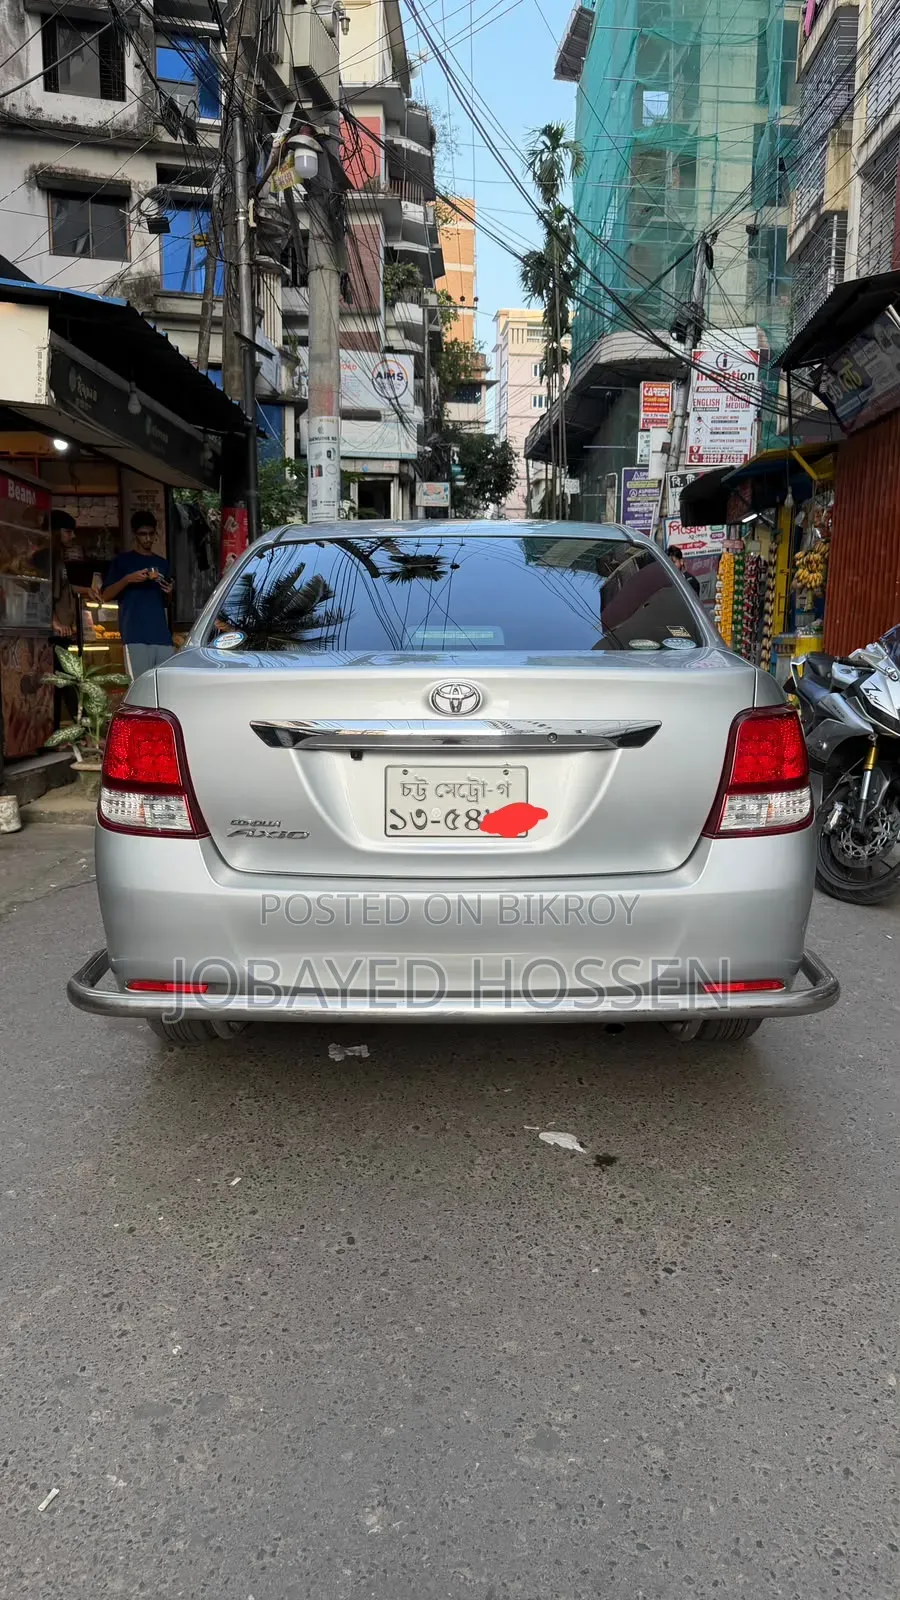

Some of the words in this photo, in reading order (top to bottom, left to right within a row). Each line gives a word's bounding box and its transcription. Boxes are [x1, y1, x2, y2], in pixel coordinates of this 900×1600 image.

[376, 372, 404, 382] AIMS
[693, 399, 720, 407] ENGLISH
[400, 775, 429, 801] চট্ট
[434, 773, 512, 803] মেট্রো-গ
[389, 808, 490, 831] ১৩-৫৪
